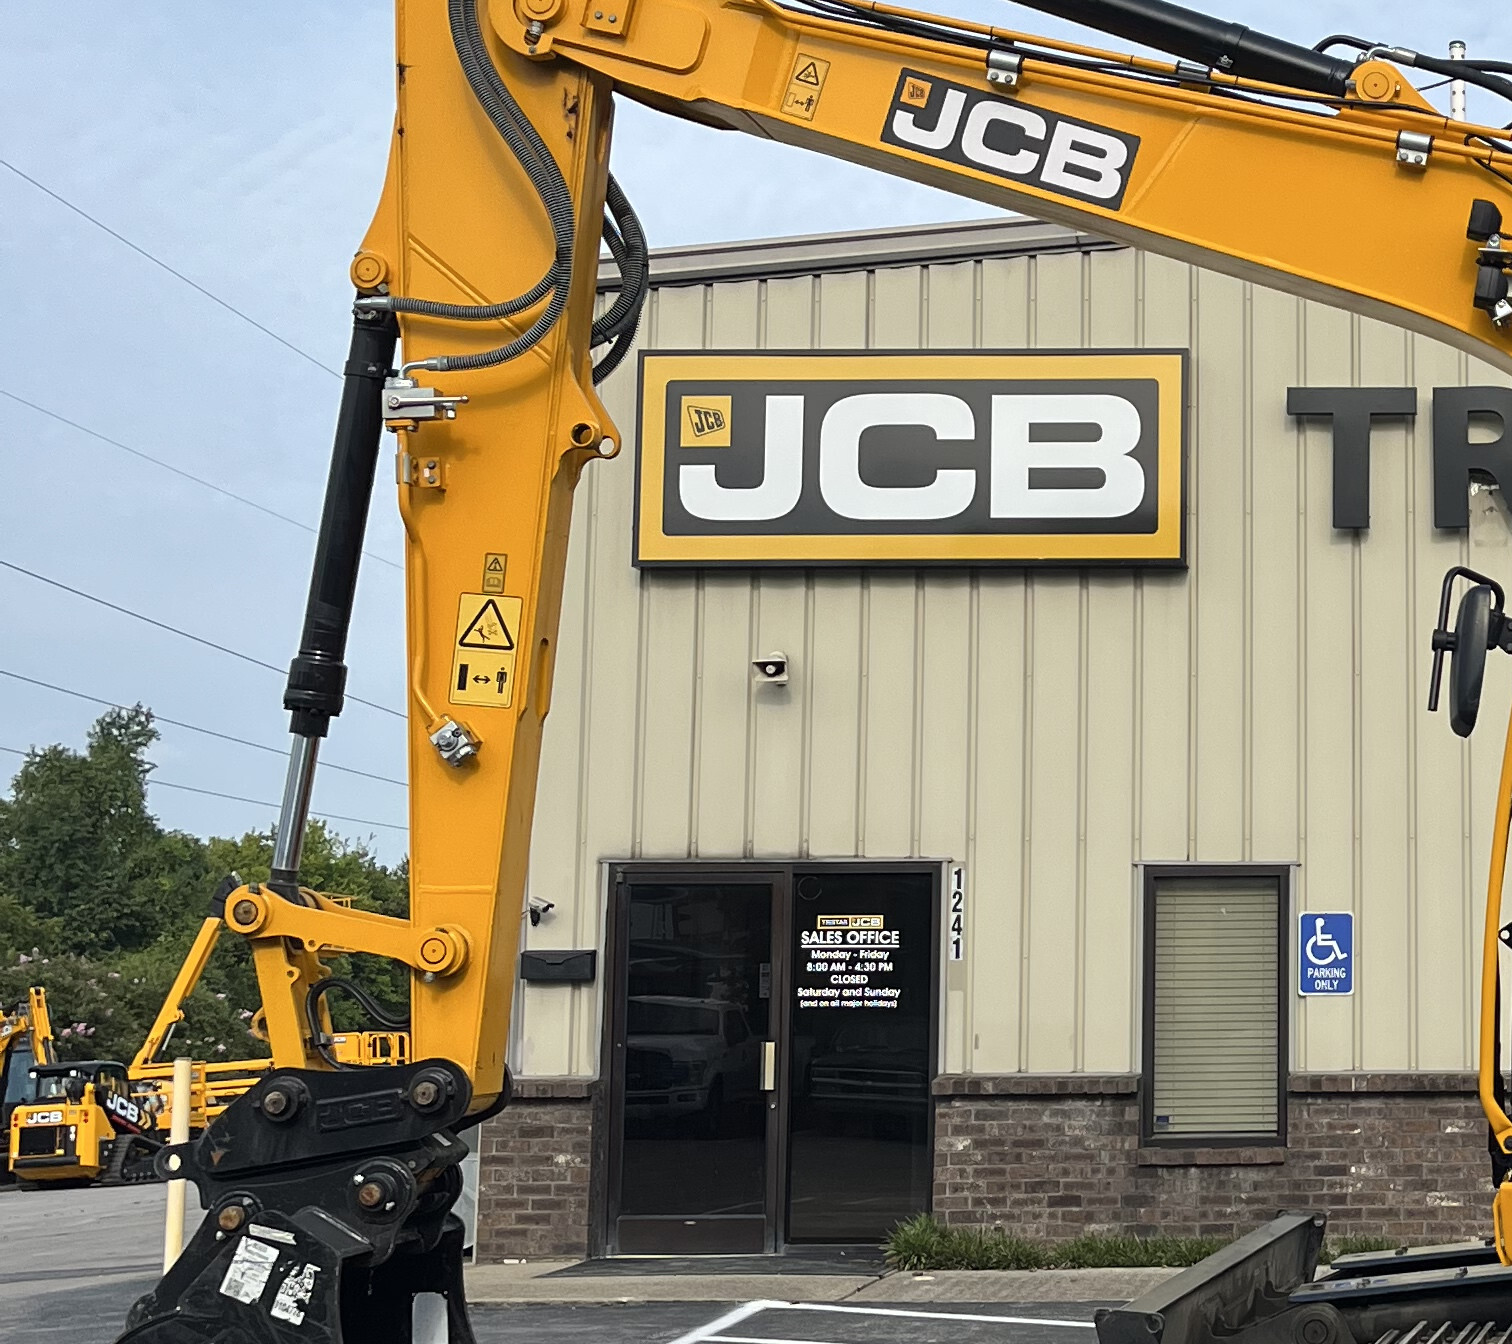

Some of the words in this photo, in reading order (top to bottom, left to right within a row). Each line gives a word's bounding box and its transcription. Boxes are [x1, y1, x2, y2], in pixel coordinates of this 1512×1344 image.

[893, 88, 1128, 199] JCB
[693, 405, 724, 434] JCB
[679, 392, 1146, 521] JCB
[951, 868, 963, 960] 1241
[851, 917, 881, 927] JCB
[801, 931, 843, 944] SALES
[846, 931, 900, 944] OFFICE
[811, 950, 852, 960] Monday
[859, 950, 890, 960] Friday
[806, 962, 828, 972] 8:00
[830, 962, 846, 971] AM
[854, 962, 876, 971] 4:30
[878, 962, 893, 971] PM
[1307, 967, 1347, 978] PARKING
[830, 975, 869, 984] CLOSED
[1314, 979, 1339, 990] ONLY
[797, 987, 841, 998] Saturday
[842, 987, 862, 997] and
[864, 987, 901, 998] Sunday
[107, 1093, 139, 1123] JCB
[27, 1111, 62, 1124] JCB
